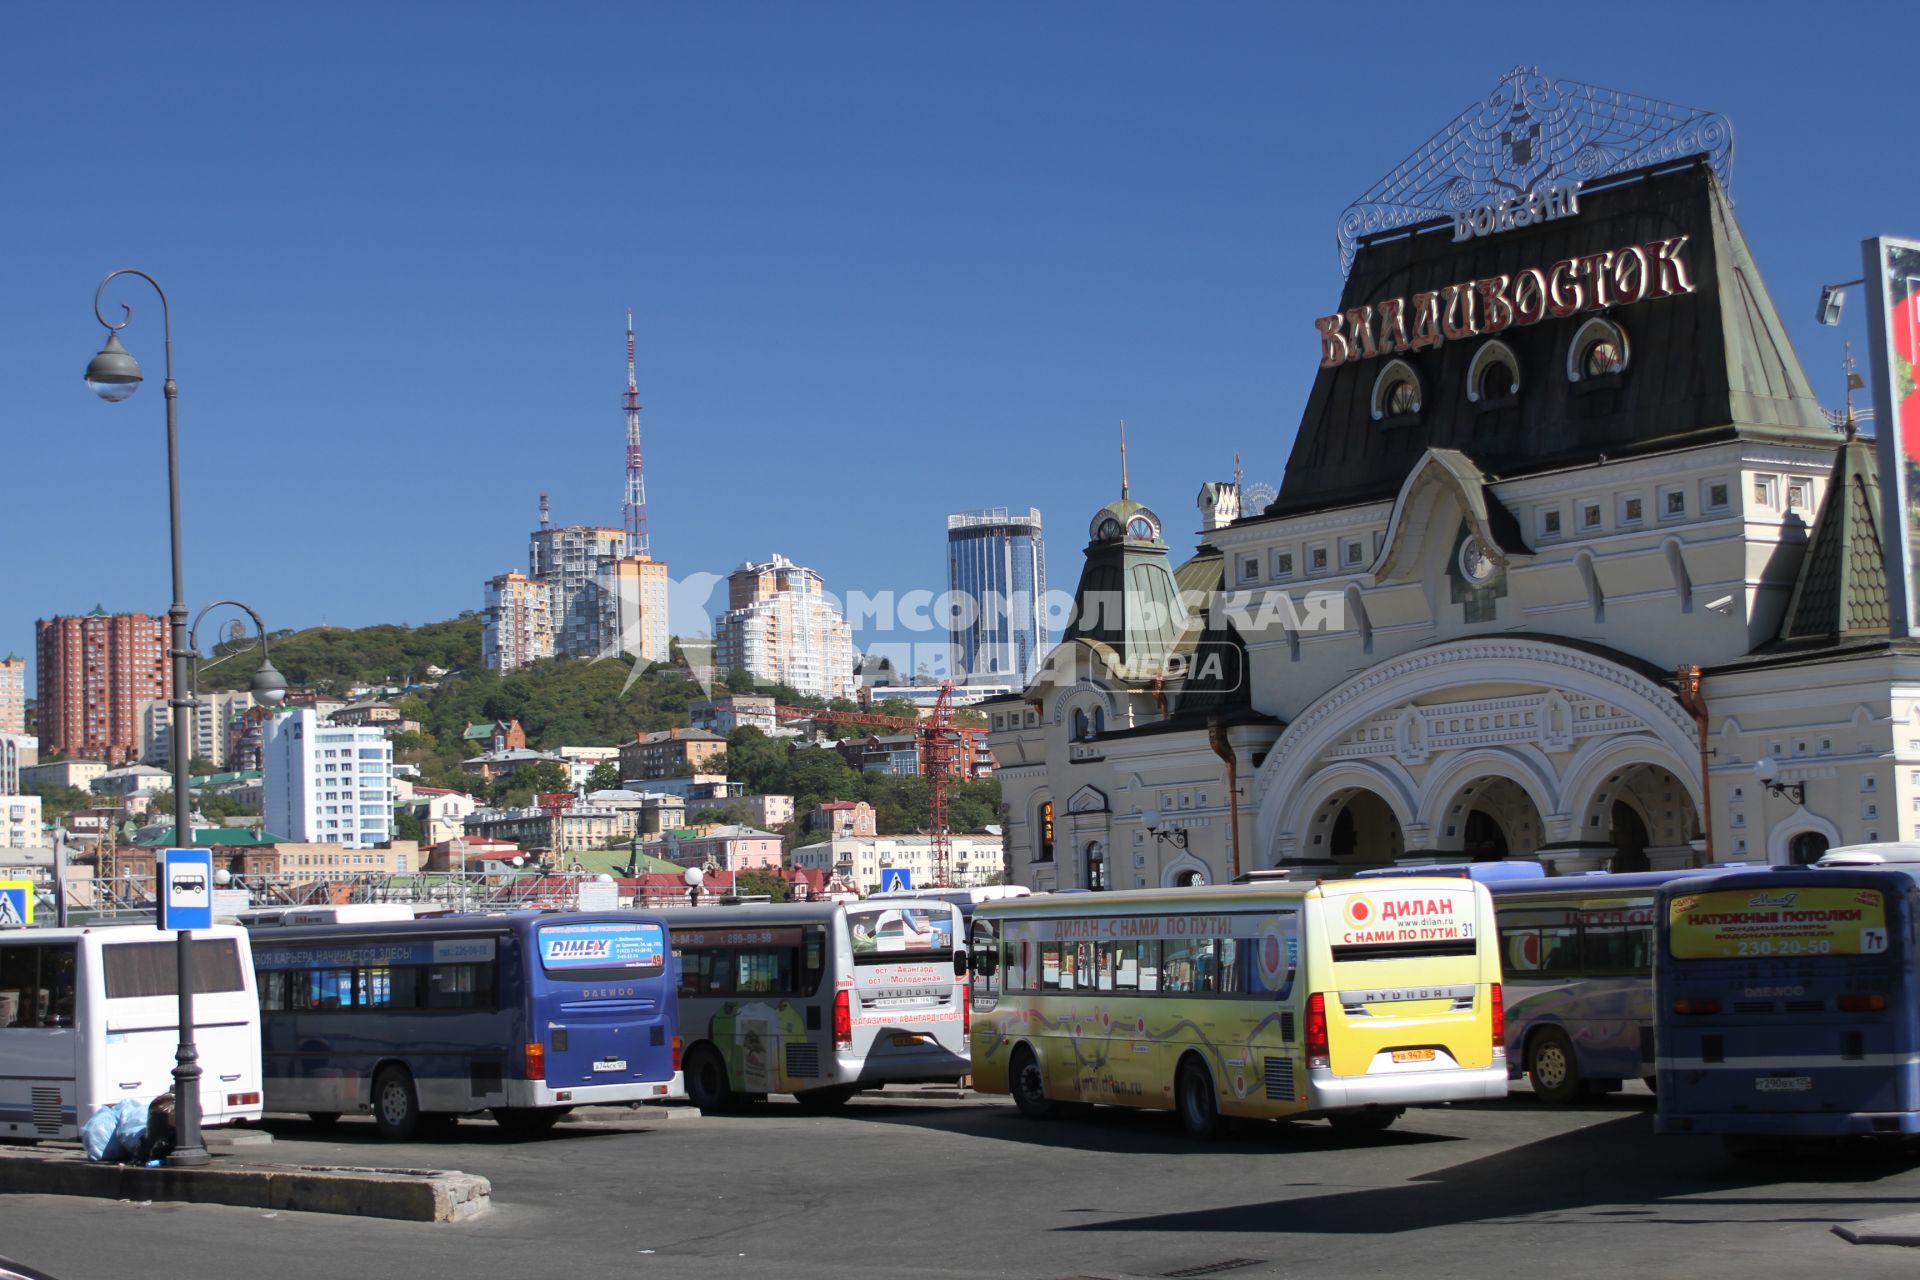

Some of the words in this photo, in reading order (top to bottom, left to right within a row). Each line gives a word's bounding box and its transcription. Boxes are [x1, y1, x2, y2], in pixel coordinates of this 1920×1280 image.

[1452, 181, 1583, 243] ВОКЗАЛ
[1315, 235, 1697, 368] ВЛАДИВОСТОК
[1382, 899, 1453, 920] ДИЛАН
[1055, 919, 1099, 940] ДИЛАН
[1121, 918, 1159, 937] НАМИ
[1166, 917, 1186, 935] ПО
[1190, 916, 1232, 935] ПУТИ!
[1397, 918, 1454, 927] www.dilan.ru
[1462, 923, 1473, 937] 31
[1344, 933, 1352, 943] С
[1356, 930, 1394, 942] НАМИ
[1399, 929, 1417, 940] ПО
[1421, 927, 1458, 939] ПУТИ!
[549, 940, 609, 957] DIMEX
[1737, 939, 1831, 955] 230-20-50
[254, 952, 272, 965] ВОЯ
[275, 950, 312, 964] КАРЬЕРА
[317, 948, 375, 963] НАЧИНАЕТСЯ
[378, 947, 412, 960] ЗДЕСЬ!
[584, 988, 634, 998] DAEWOO
[878, 988, 938, 997] HYUNDAI
[1366, 989, 1452, 1001] HYUNDAI
